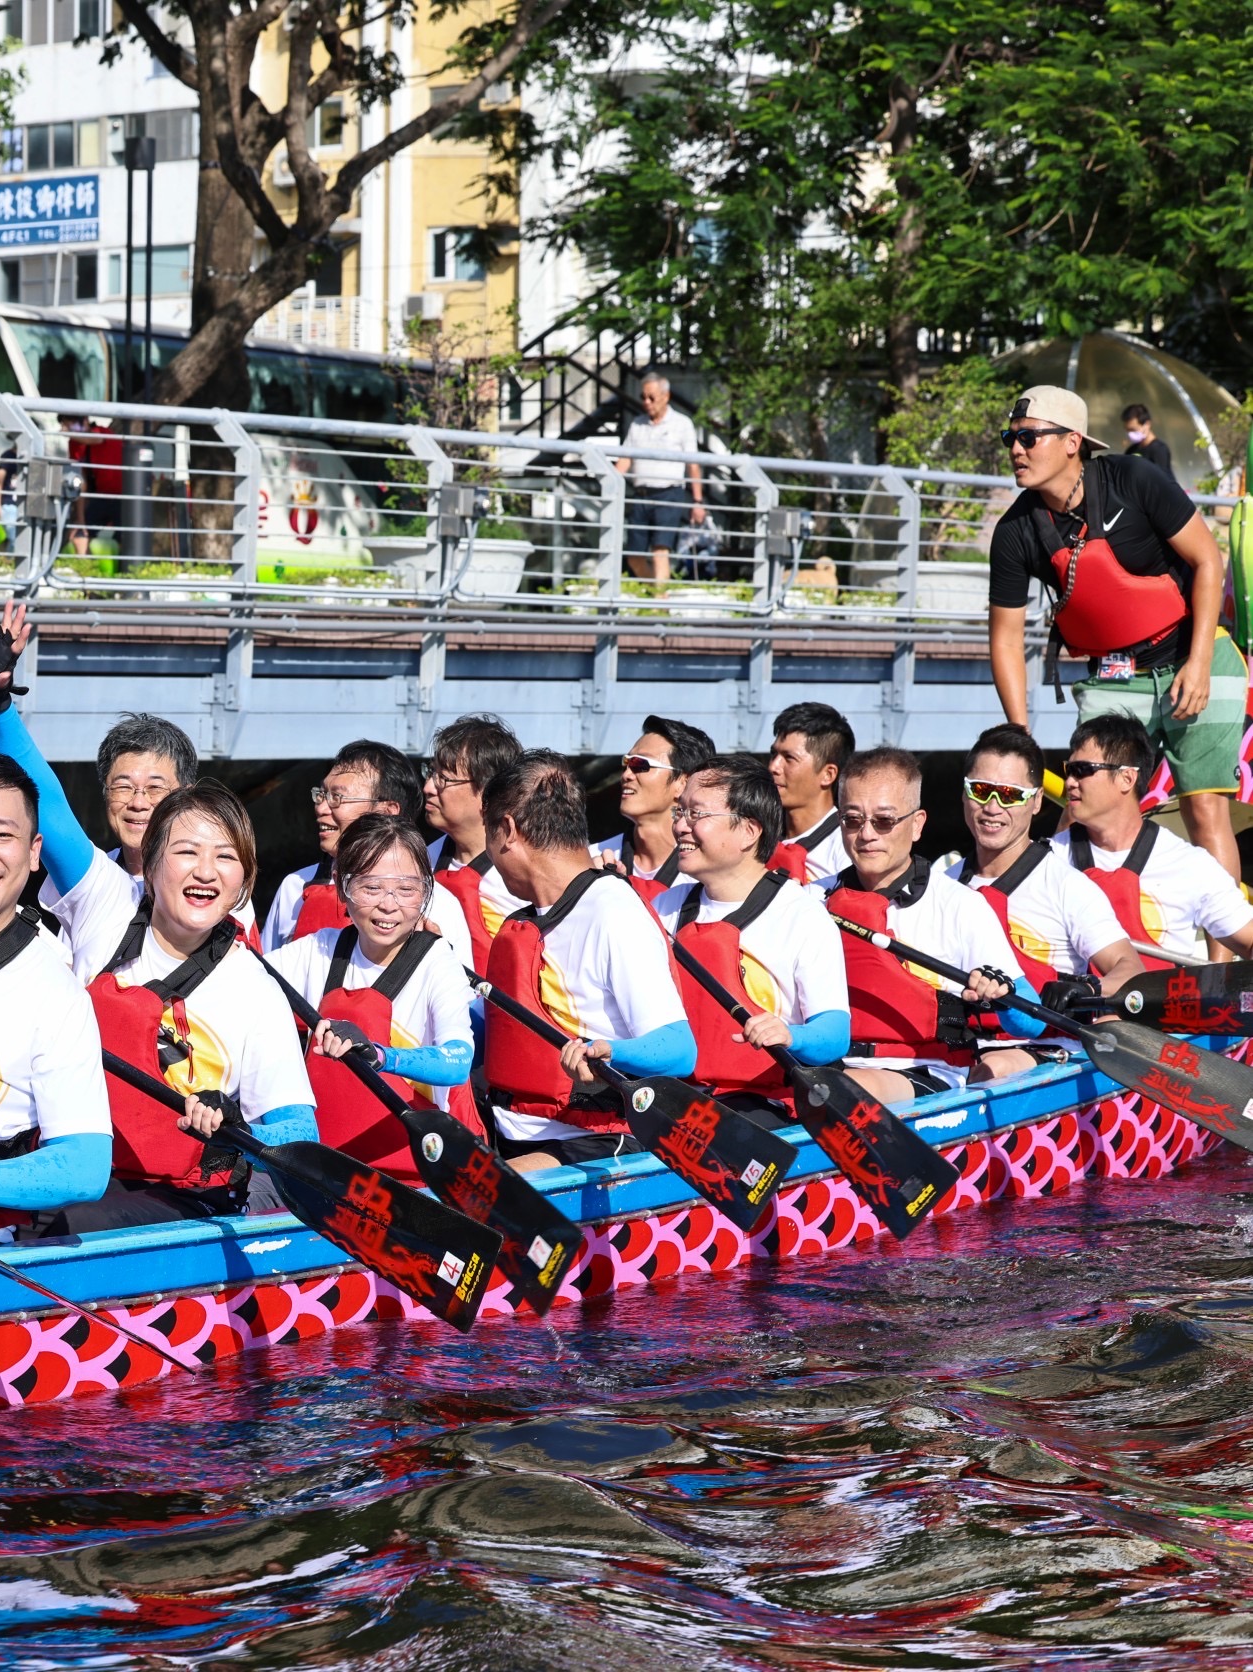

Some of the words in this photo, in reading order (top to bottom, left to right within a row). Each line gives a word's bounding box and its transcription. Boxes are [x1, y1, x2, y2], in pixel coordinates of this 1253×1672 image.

[745, 1165, 761, 1184] 15
[442, 1260, 461, 1280] 4
[454, 1252, 481, 1302] Brácsa
